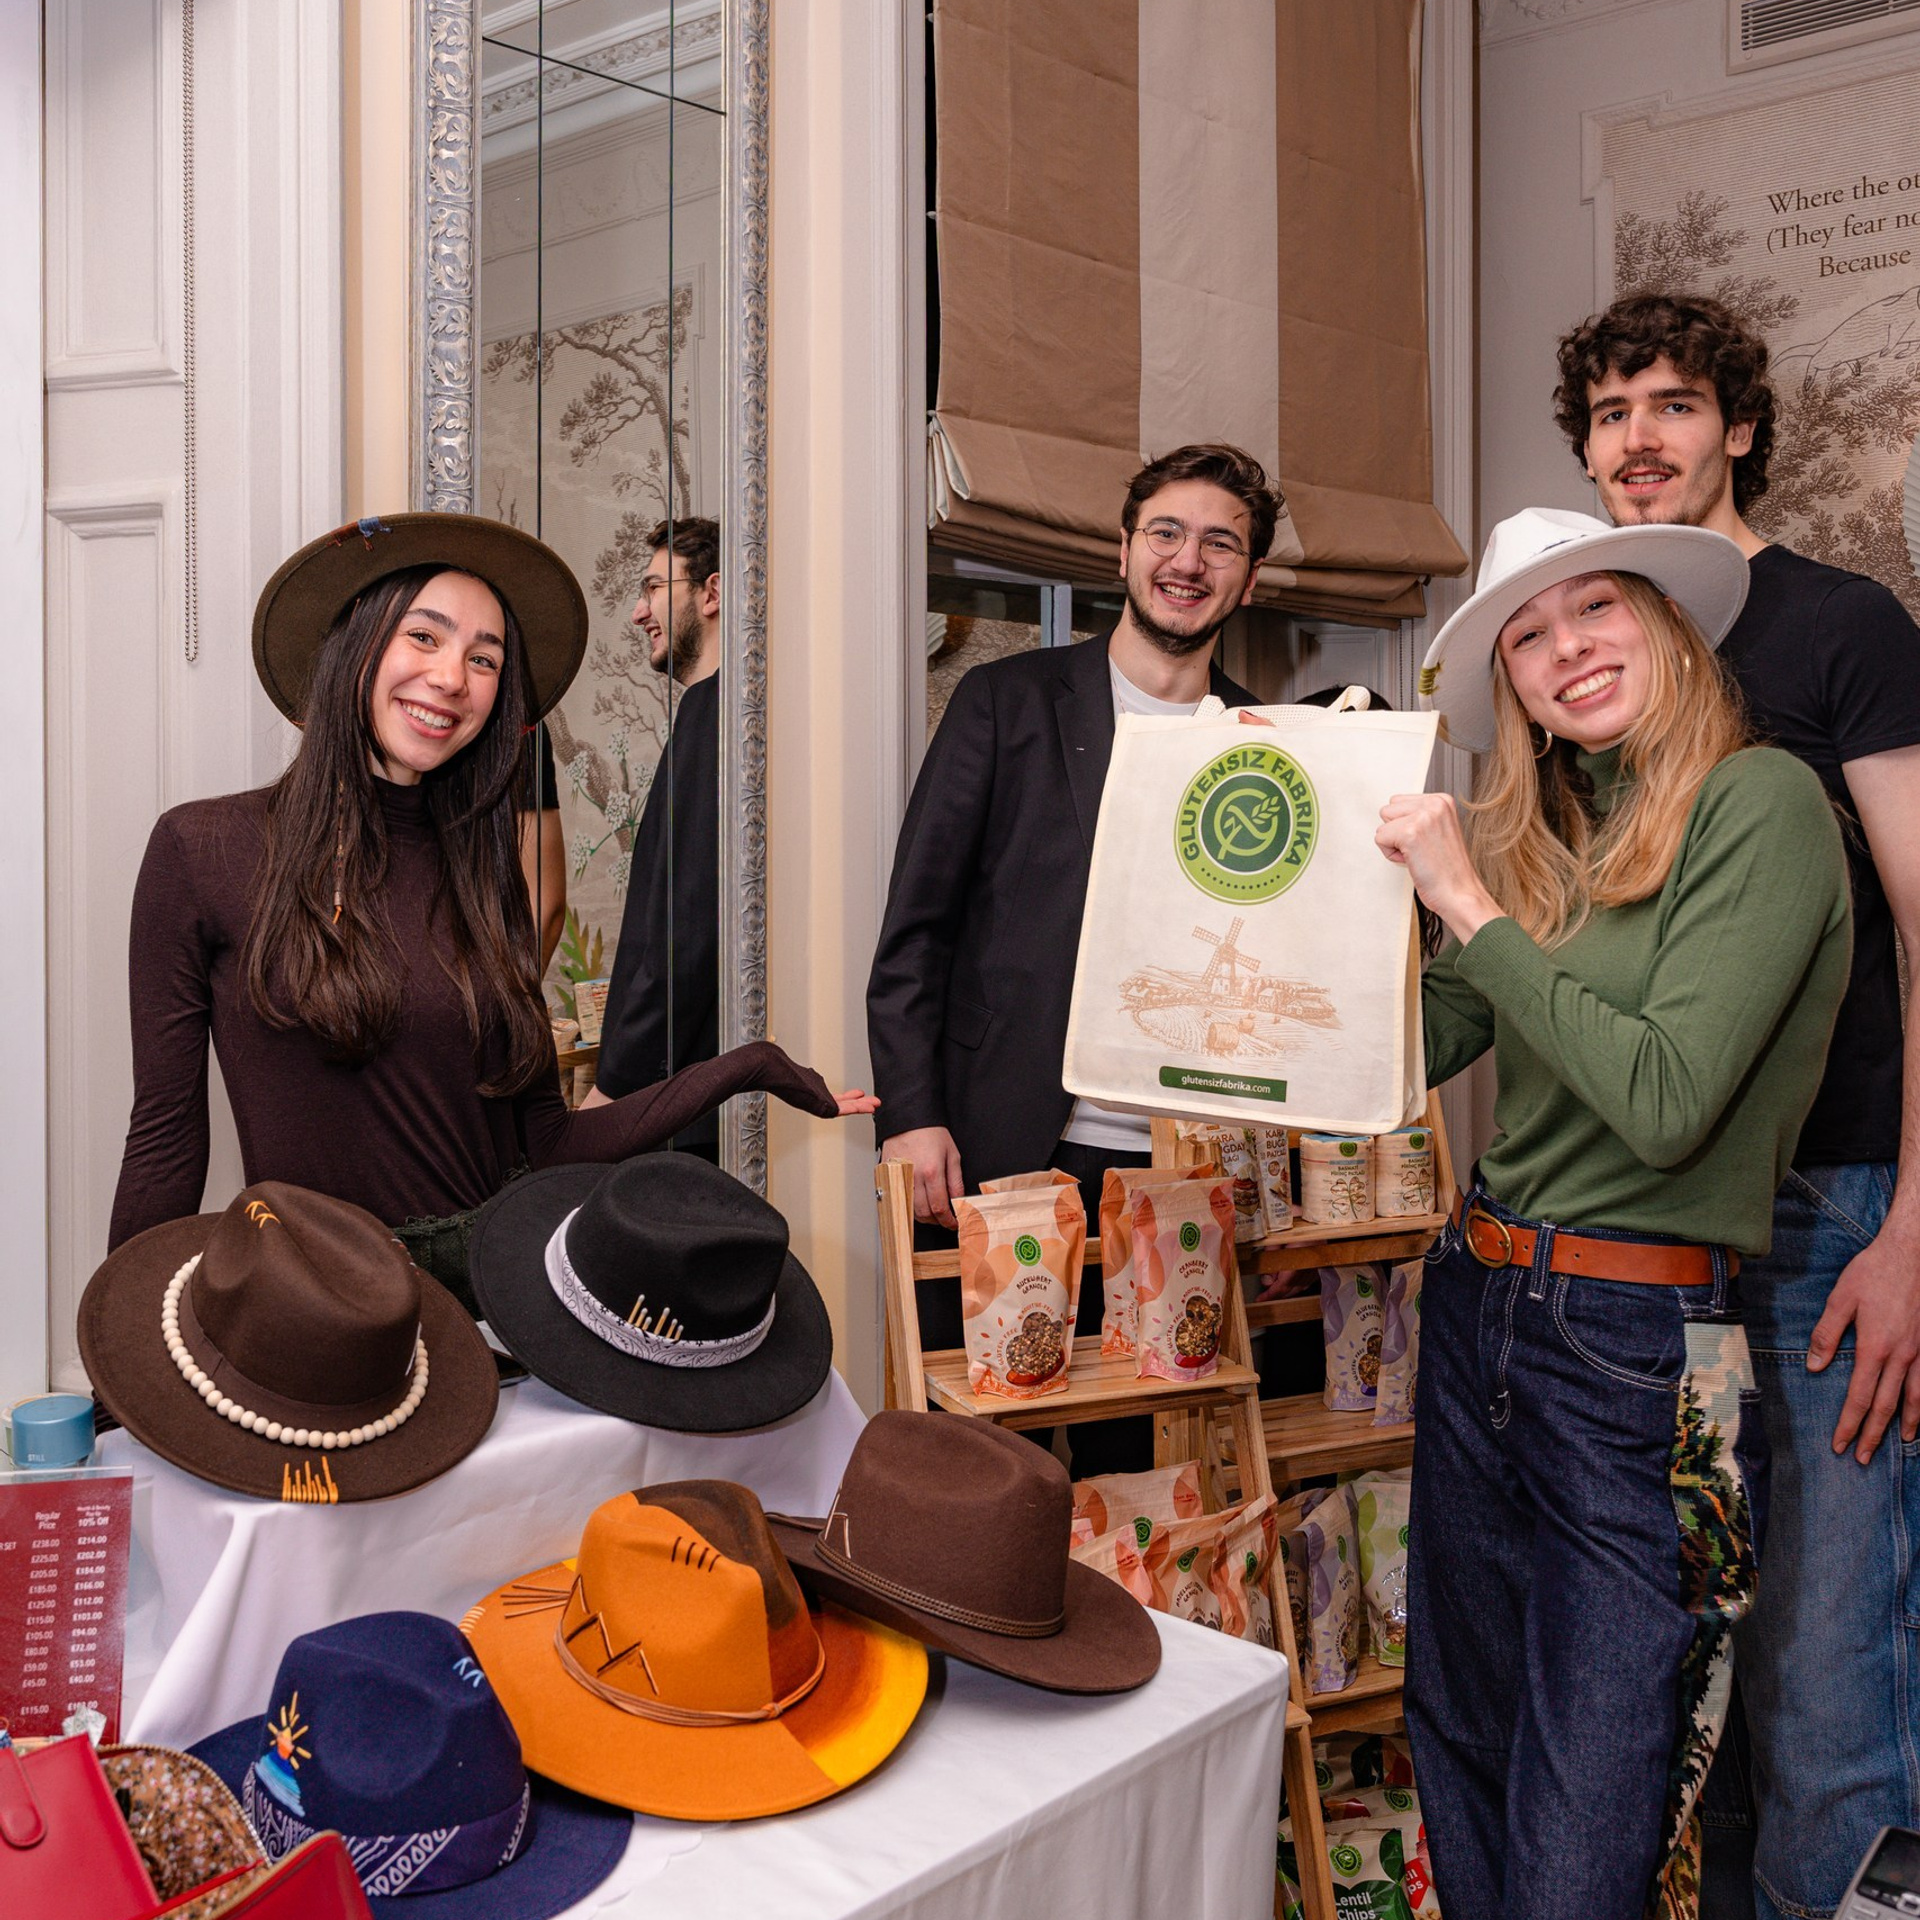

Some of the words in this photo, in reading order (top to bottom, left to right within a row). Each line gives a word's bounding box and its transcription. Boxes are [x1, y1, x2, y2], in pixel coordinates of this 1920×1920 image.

[1767, 188, 1844, 214] Where
[1853, 175, 1889, 200] the
[1767, 223, 1835, 254] (They
[1844, 213, 1887, 238] fear
[1819, 249, 1911, 278] Because
[1181, 750, 1267, 862] GLUTENSIZ
[1270, 756, 1312, 866] FABRIKA
[1181, 1074, 1271, 1094] glutensizfabrika.com
[1223, 1142, 1246, 1154] ĞDAY
[35, 1511, 60, 1521] Regular
[78, 1518, 96, 1527] 10%
[97, 1516, 109, 1526] Off
[38, 1521, 56, 1530] Price
[79, 1536, 106, 1546] £214.00
[1335, 1891, 1372, 1906] entil
[1337, 1908, 1377, 1920] Chips
